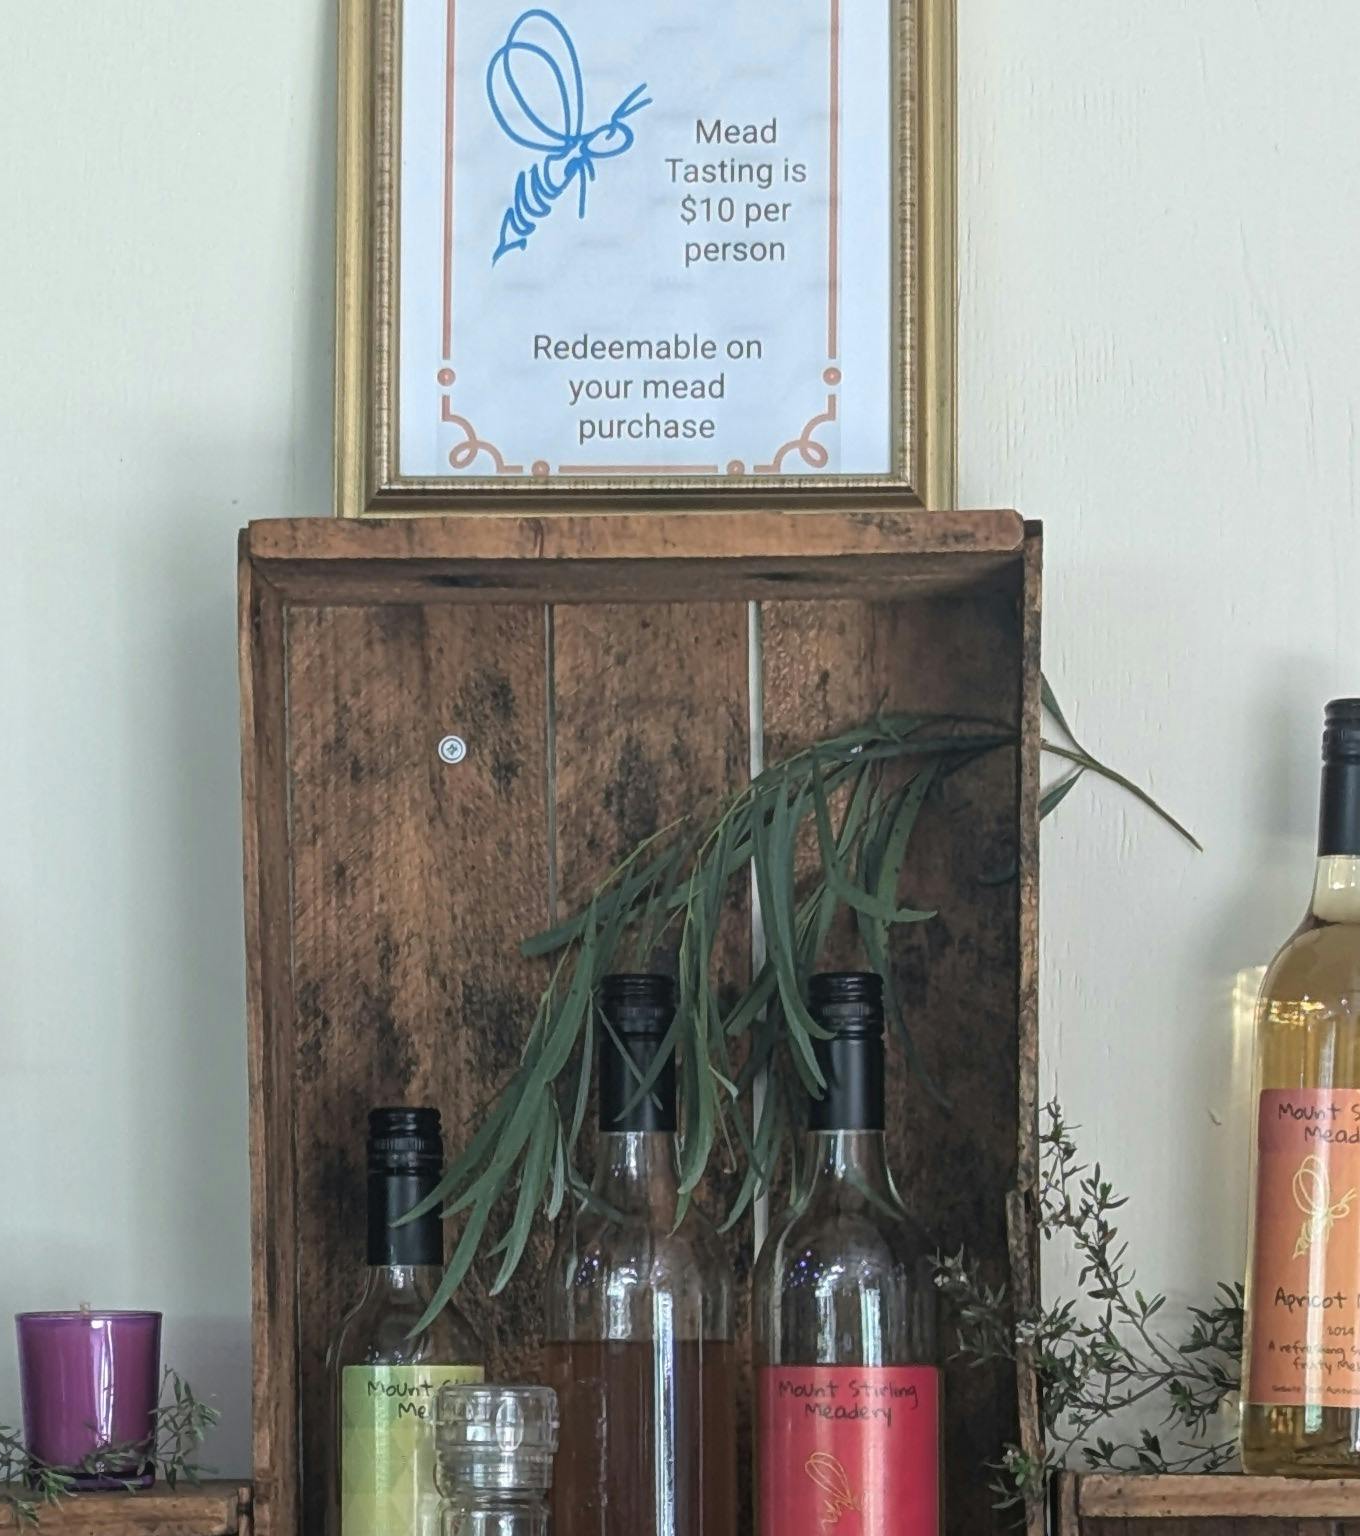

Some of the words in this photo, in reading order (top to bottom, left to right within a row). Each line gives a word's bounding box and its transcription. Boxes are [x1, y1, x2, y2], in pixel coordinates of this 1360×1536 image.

[695, 119, 777, 144] Mead
[666, 158, 774, 189] Tasting
[784, 158, 806, 184] is
[680, 196, 735, 225] $10
[745, 200, 791, 227] per
[685, 240, 786, 267] person
[534, 334, 716, 360] Redeemable
[726, 340, 762, 360] on
[569, 378, 633, 405] your
[643, 373, 725, 399] mead
[579, 413, 716, 444] purchase
[1278, 1103, 1340, 1122] Mount
[1275, 1287, 1346, 1313] Apricot
[368, 1381, 433, 1397] Mount
[779, 1380, 838, 1399] Mount
[849, 1380, 918, 1410] Stirling
[805, 1403, 891, 1427] Meadery
